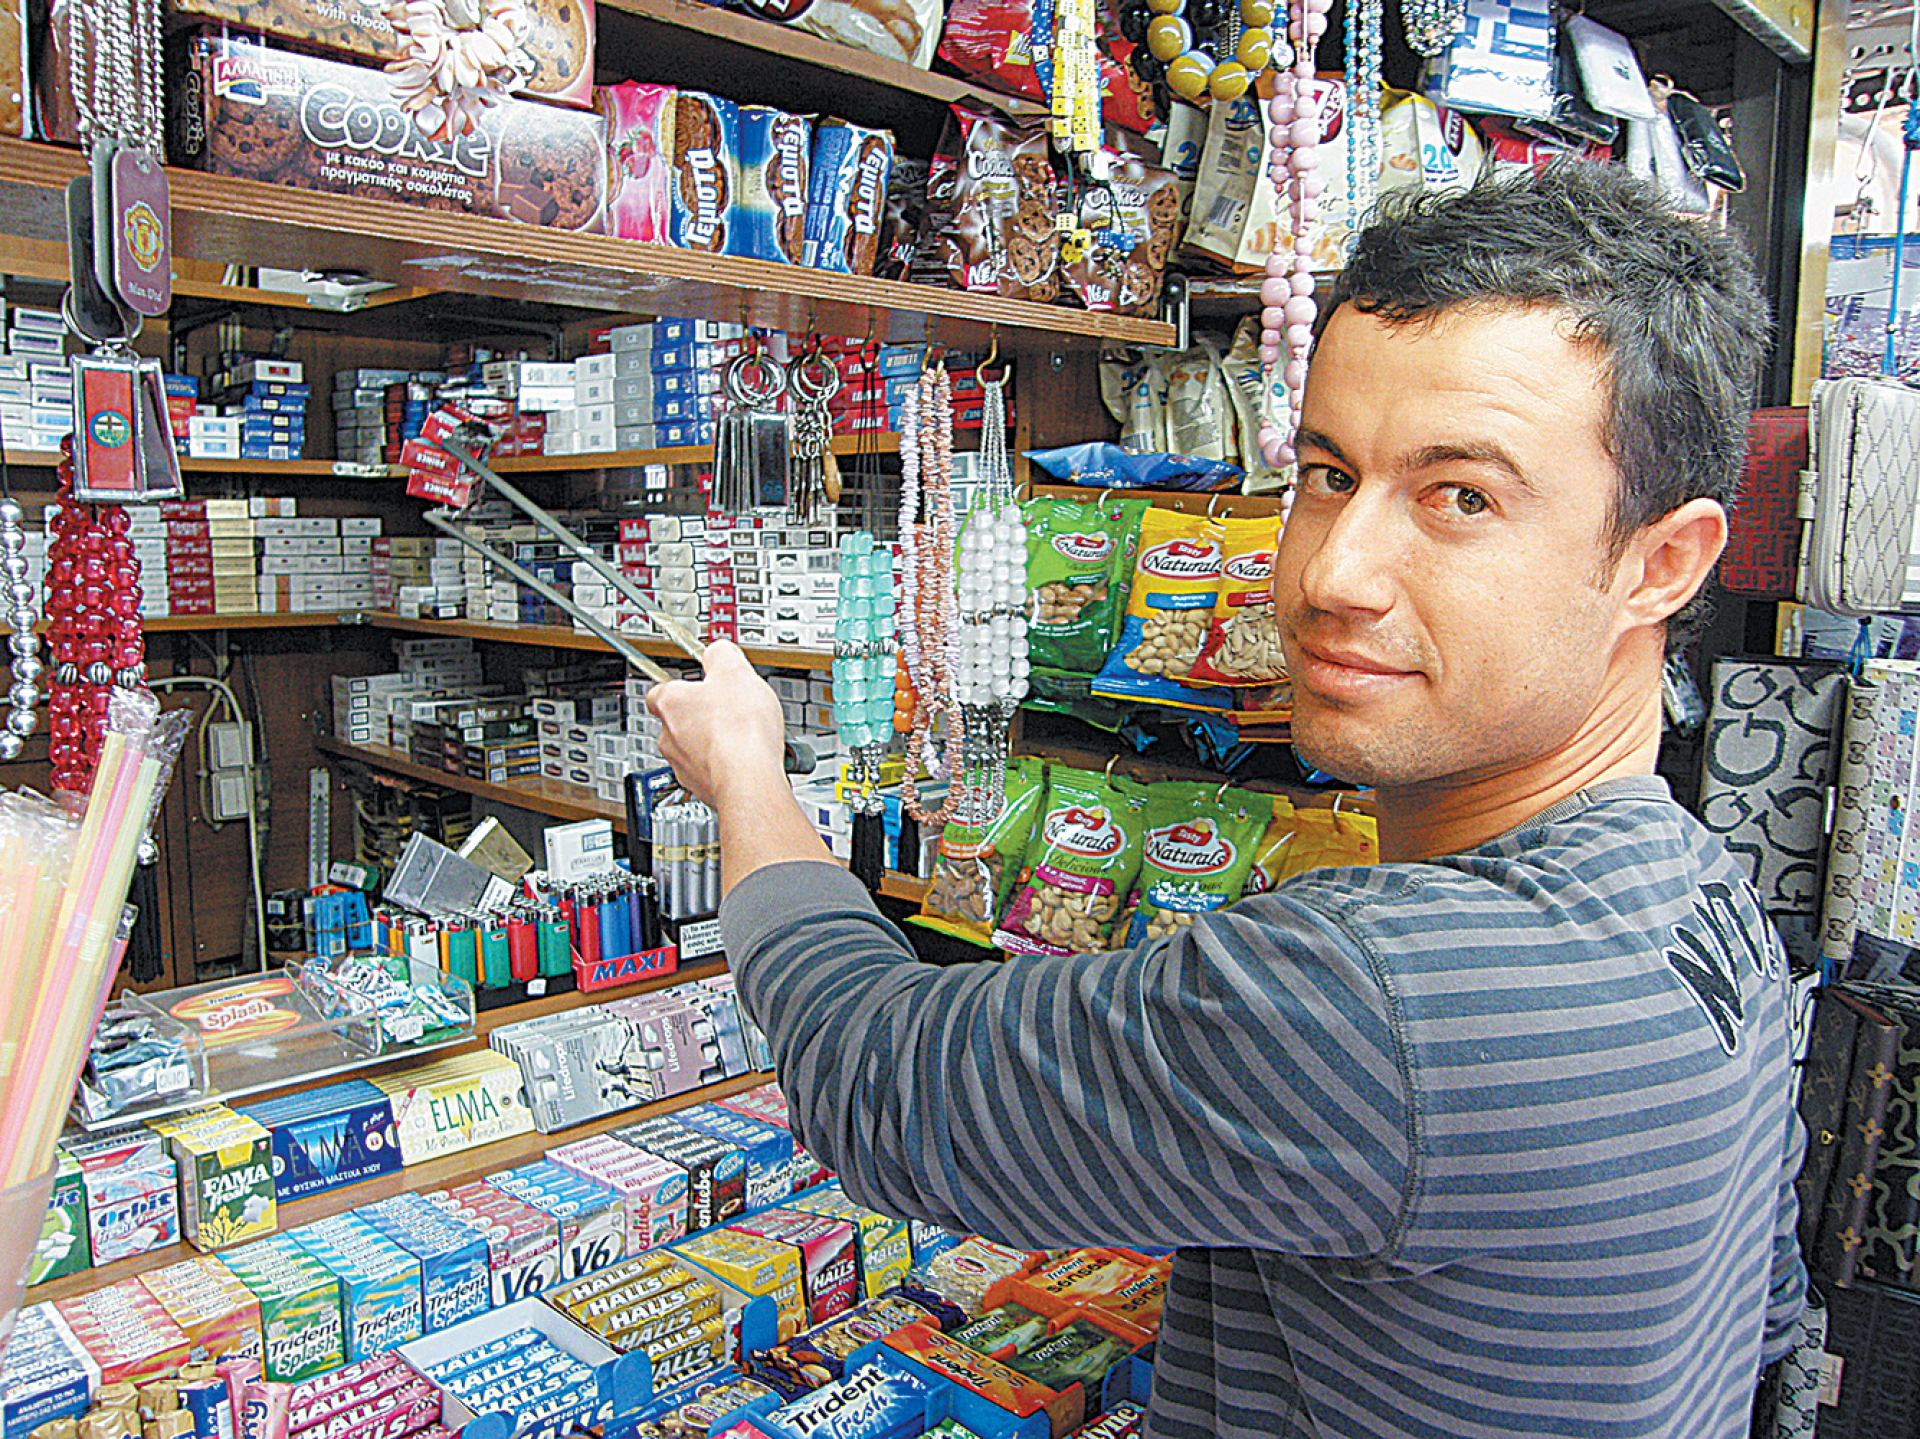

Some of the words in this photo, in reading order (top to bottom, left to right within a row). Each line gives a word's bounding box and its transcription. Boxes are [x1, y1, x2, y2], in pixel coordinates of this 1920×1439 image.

[315, 4, 347, 21] with
[350, 11, 395, 35] chocol
[320, 165, 403, 194] πραγματικής
[405, 180, 473, 204] σοκολάτας
[325, 152, 341, 166] με
[344, 154, 385, 172] κακάο
[388, 162, 408, 176] και
[411, 164, 466, 187] κομμάτια
[1047, 821, 1116, 853] Nurals
[1147, 841, 1227, 867] Naturals
[592, 952, 666, 983] MAXI
[206, 1000, 271, 1028] Splash
[556, 1040, 575, 1101] Lifedrops
[428, 1087, 500, 1133] ELMA
[202, 1163, 271, 1199] FAMA
[571, 1233, 618, 1279] V6
[870, 1238, 908, 1265] HALLS
[1045, 1257, 1085, 1282] Trident
[429, 1274, 487, 1312] Trident
[500, 1261, 547, 1302] V6
[572, 1260, 644, 1301] HALLS
[771, 1281, 797, 1300] ALLS
[814, 1259, 857, 1292] HALLS
[1046, 1258, 1113, 1294] senses
[1117, 1273, 1158, 1298] Trident
[434, 1292, 484, 1328] Splash
[590, 1275, 664, 1317] HALLS
[611, 1290, 686, 1331] HALLS
[1120, 1282, 1169, 1313] sens
[356, 1300, 420, 1339] Trident
[362, 1318, 416, 1354] Splash
[960, 1315, 1001, 1341] Trident
[269, 1318, 339, 1360] Trident
[276, 1337, 337, 1376] Splash
[648, 1325, 702, 1358] ALLS
[1032, 1334, 1075, 1362] Trident
[428, 1338, 506, 1382] HALLS
[446, 1352, 525, 1396] HALLS
[652, 1342, 711, 1382] ALLS
[290, 1364, 364, 1403] ALLS
[786, 1367, 886, 1435] Trident
[290, 1380, 380, 1429] HALLS
[301, 1394, 397, 1439] HALLS
[516, 1390, 579, 1431] ALLS
[830, 1389, 890, 1439] Fresh
